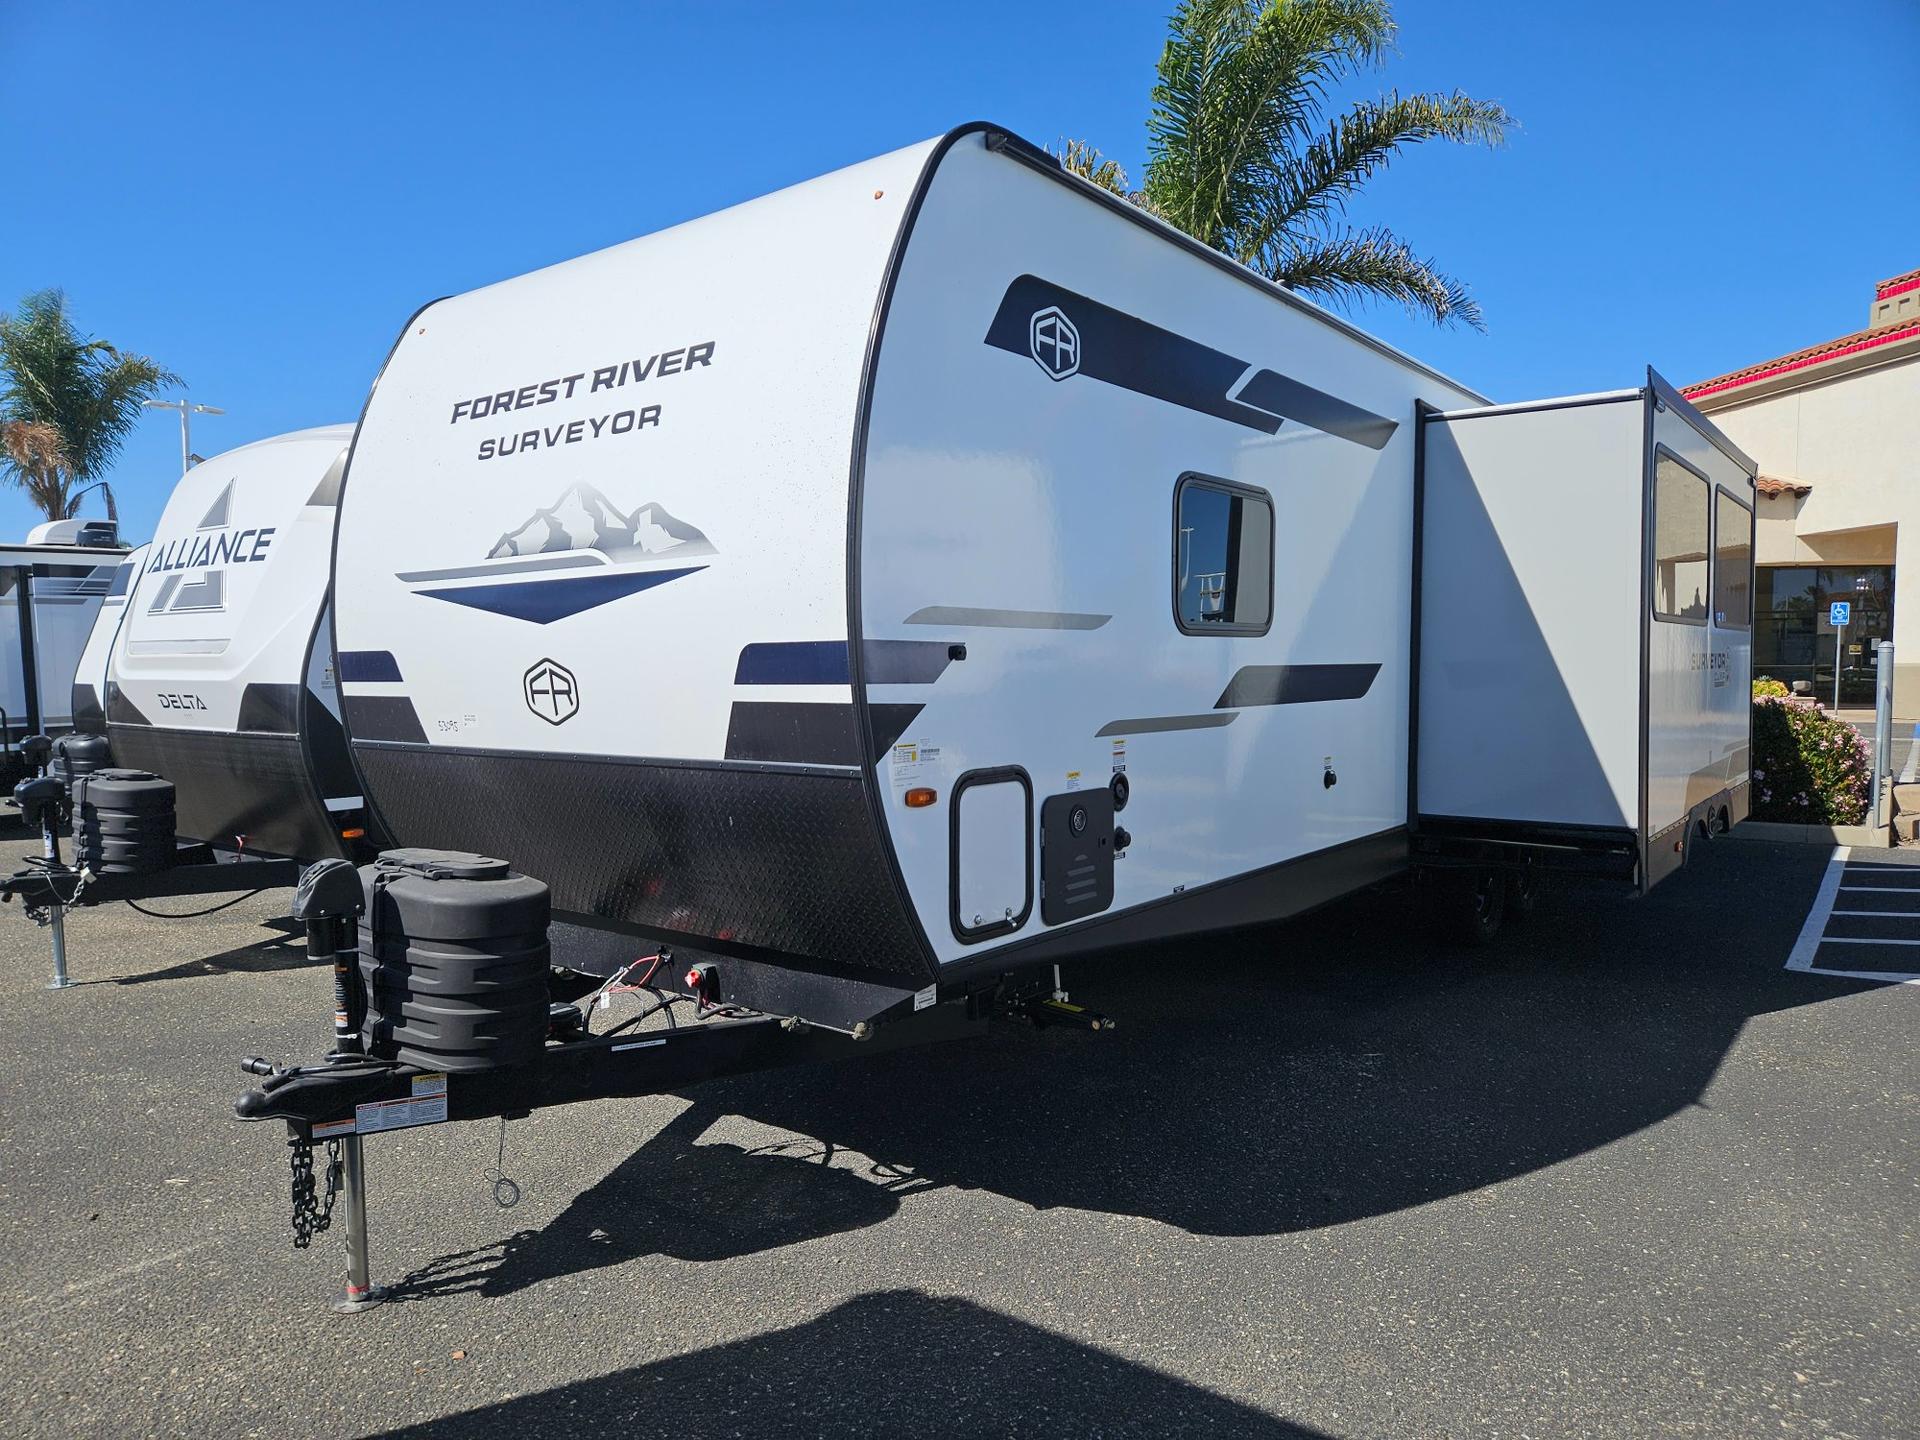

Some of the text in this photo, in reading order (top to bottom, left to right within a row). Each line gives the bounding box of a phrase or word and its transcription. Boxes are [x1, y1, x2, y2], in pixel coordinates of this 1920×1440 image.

[450, 341, 716, 424] FOREST RIVER
[477, 404, 662, 461] SURVEYOR
[147, 527, 277, 574] ALLIANCE
[1691, 652, 1727, 670] SURVEYOR
[157, 693, 208, 710] DELTA
